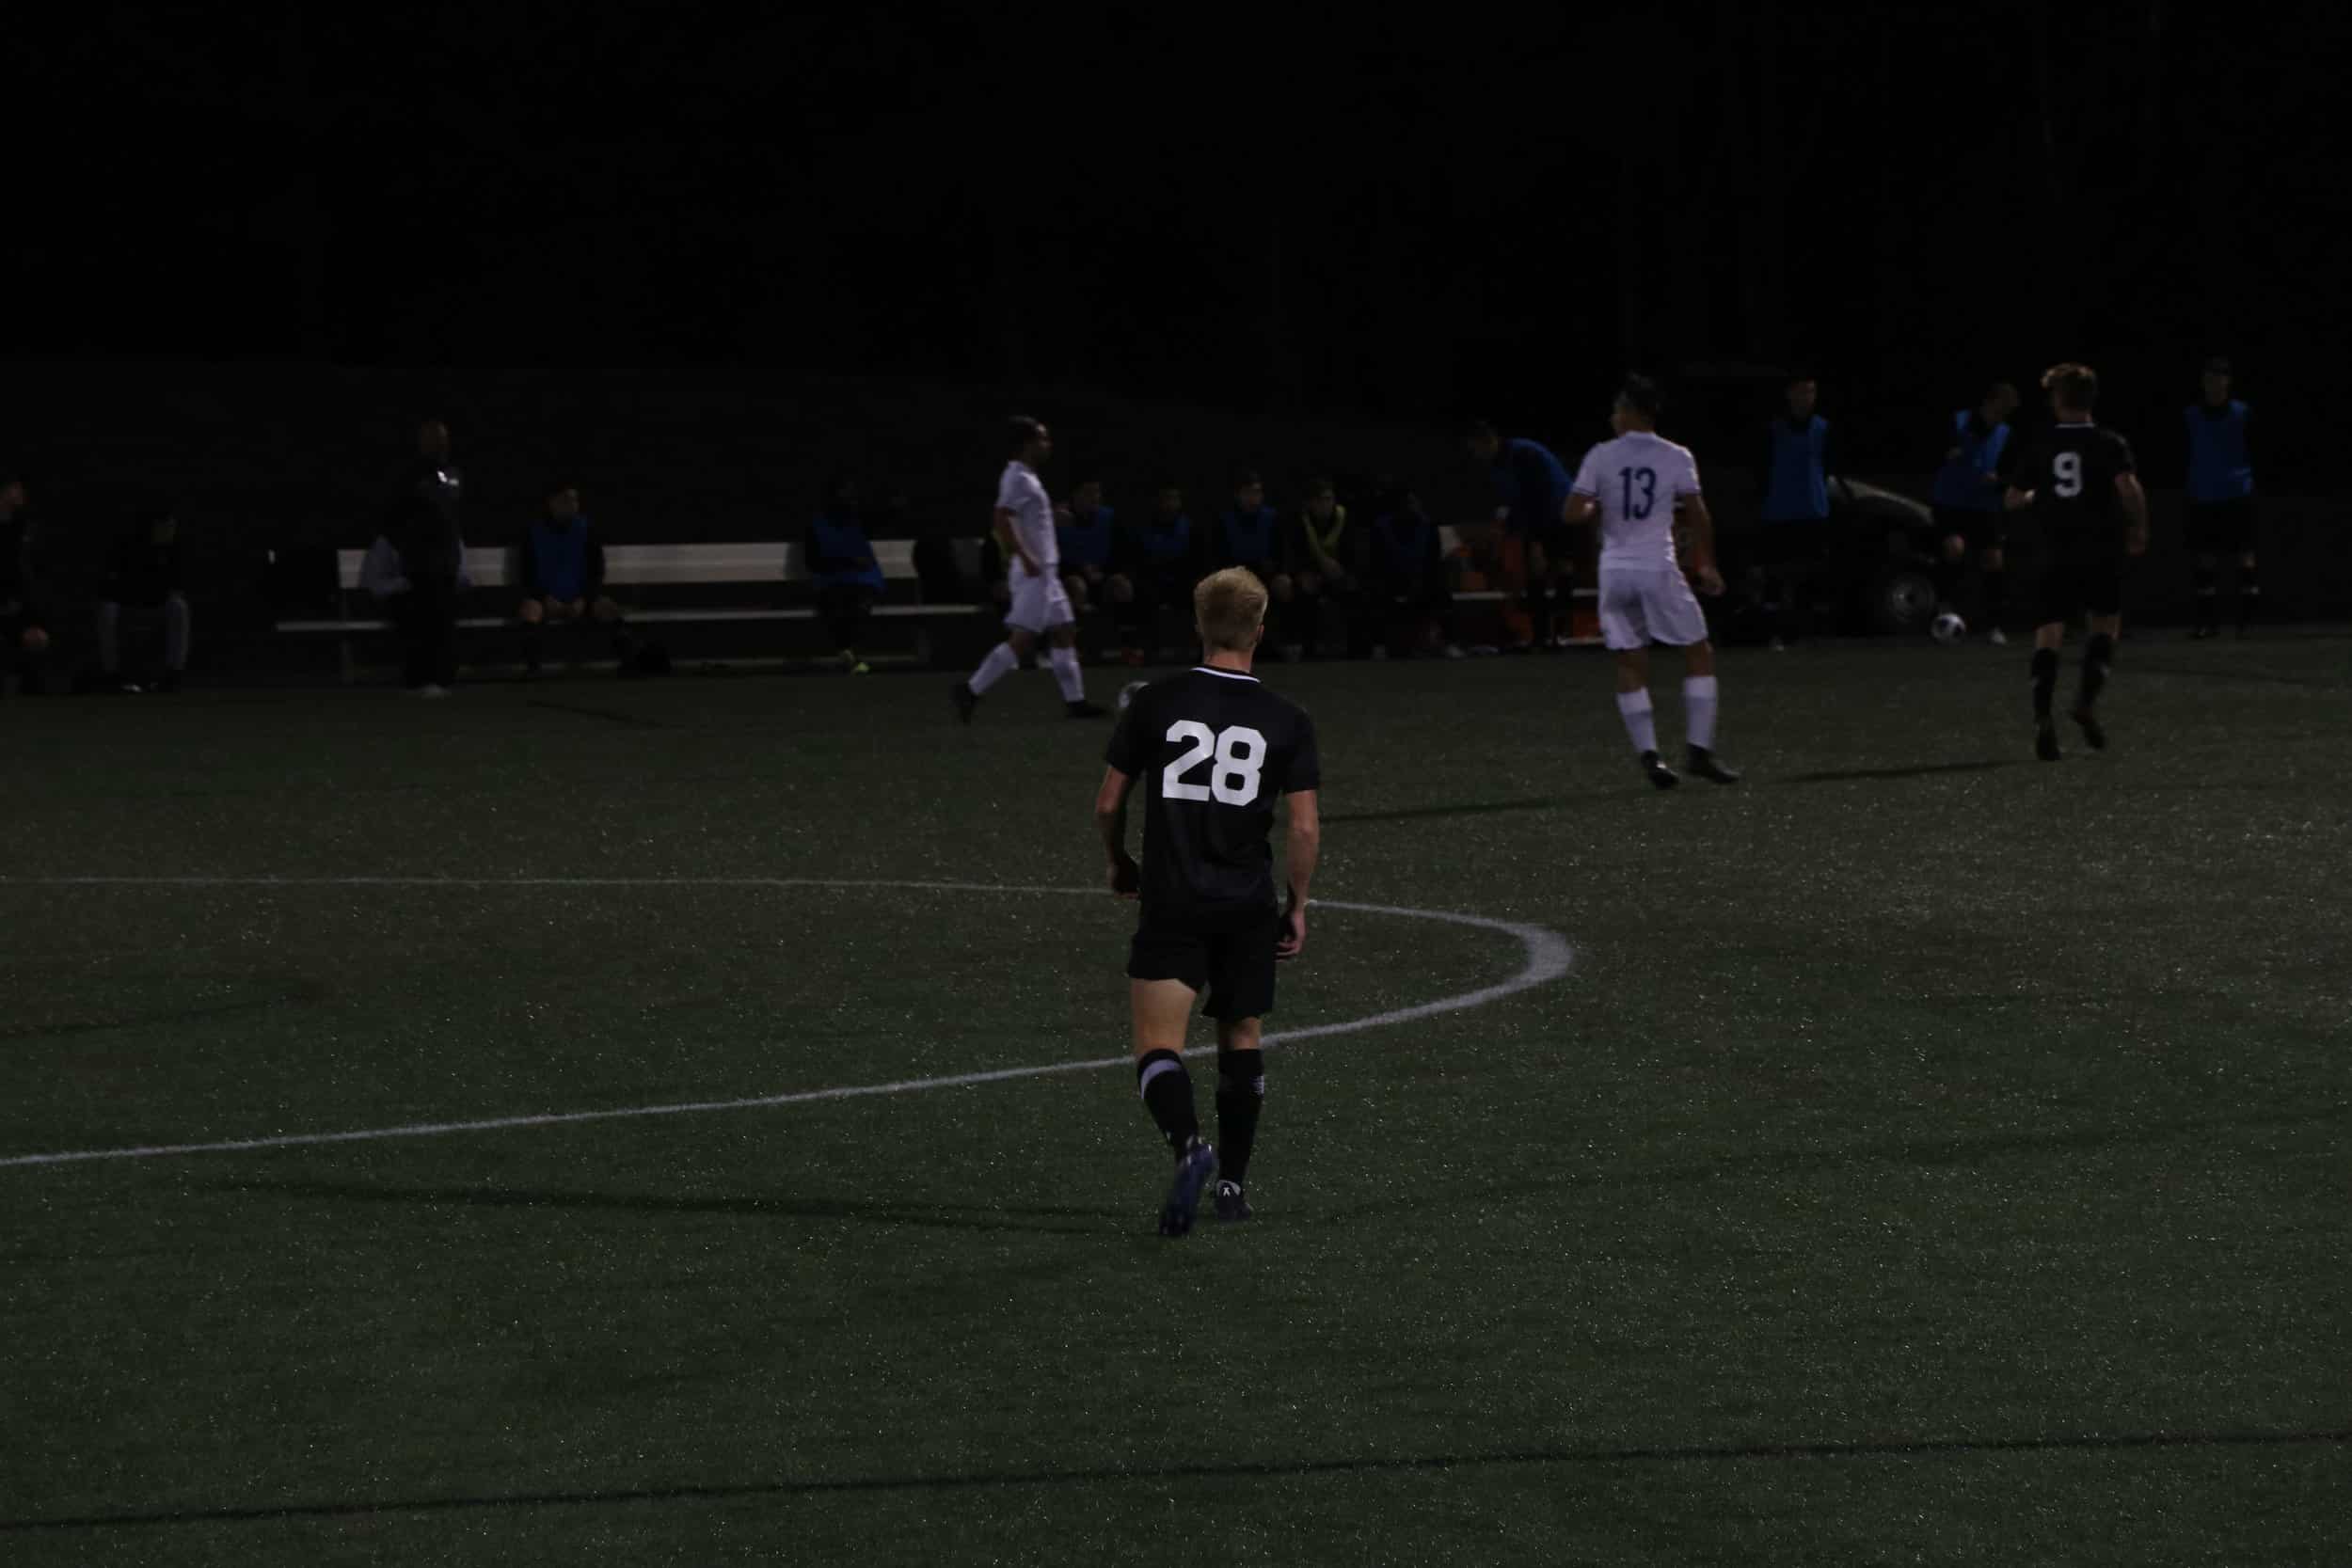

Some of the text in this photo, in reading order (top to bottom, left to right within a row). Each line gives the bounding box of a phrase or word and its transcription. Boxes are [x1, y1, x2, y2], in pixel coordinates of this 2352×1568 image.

[1620, 467, 1656, 521] 13
[2053, 451, 2083, 498] 9
[1162, 720, 1267, 806] 28
